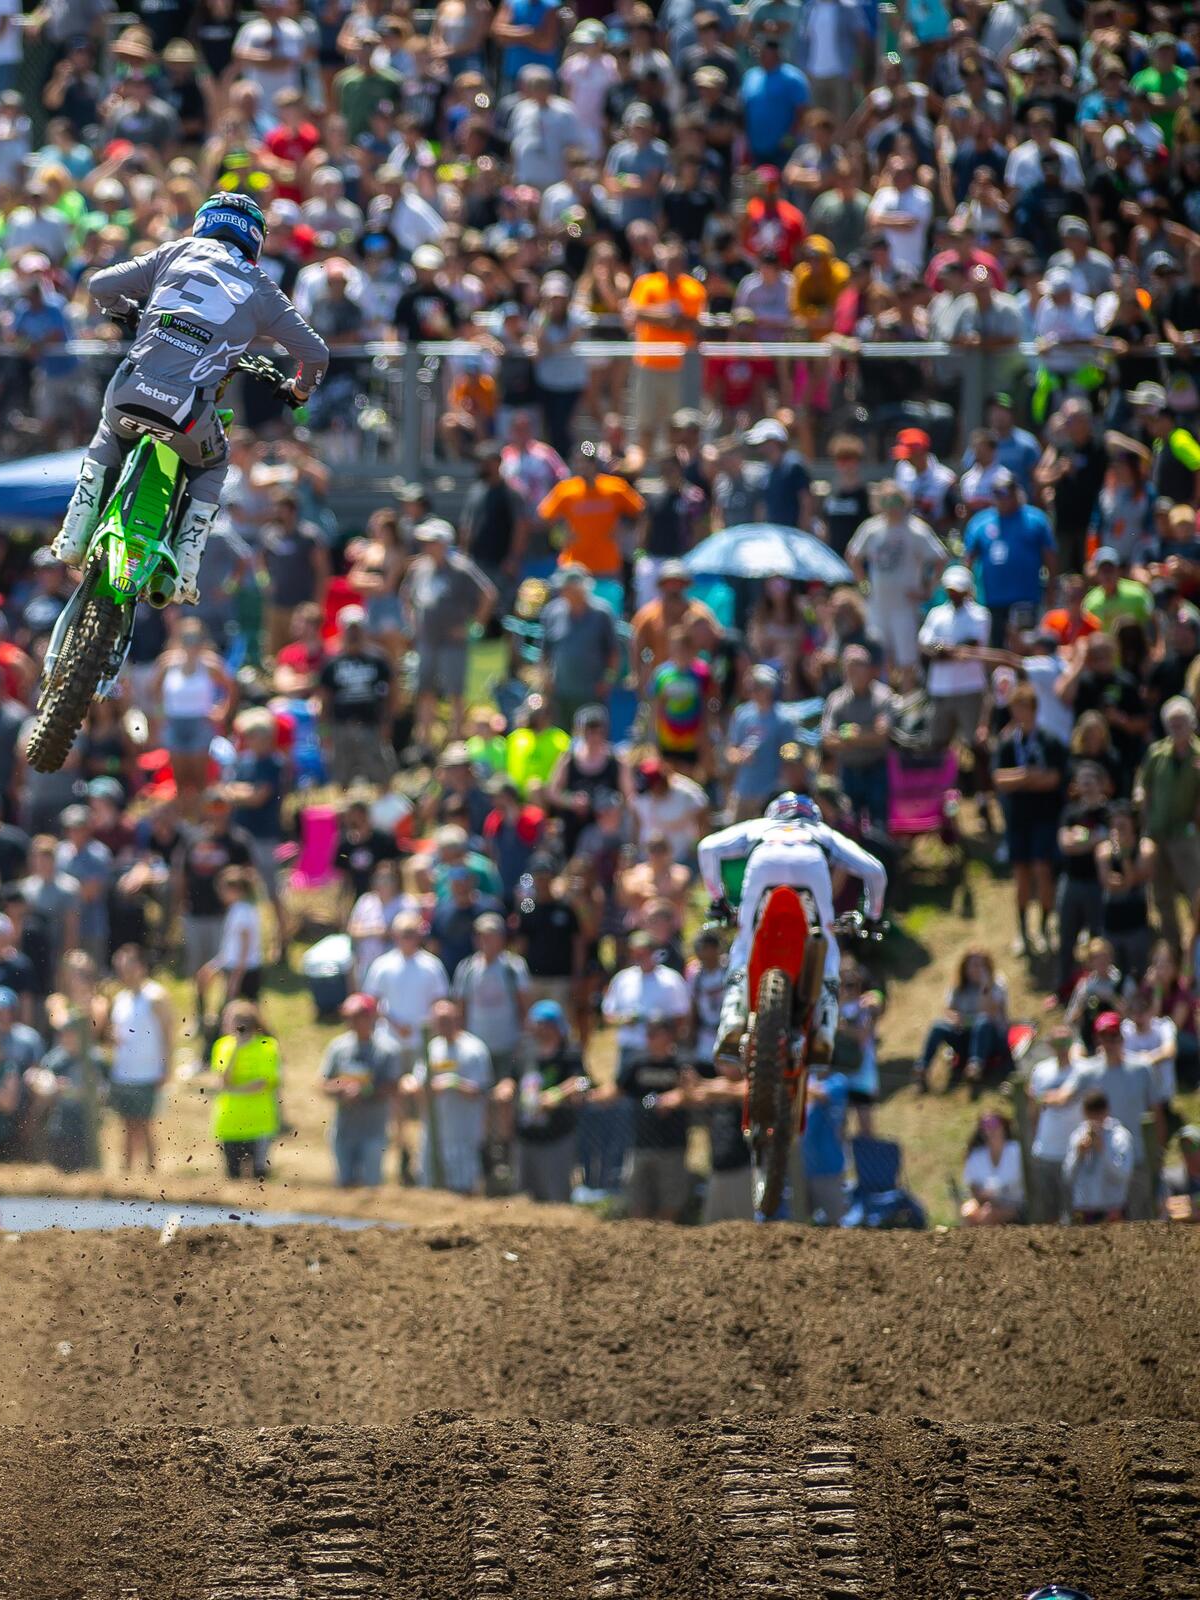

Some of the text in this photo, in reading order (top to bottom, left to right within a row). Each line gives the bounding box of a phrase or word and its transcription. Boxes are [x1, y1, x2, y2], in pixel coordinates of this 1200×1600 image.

[152, 261, 254, 325] 3
[152, 328, 204, 357] Kawasaki
[135, 382, 179, 405] Astars
[119, 416, 175, 442] ET3
